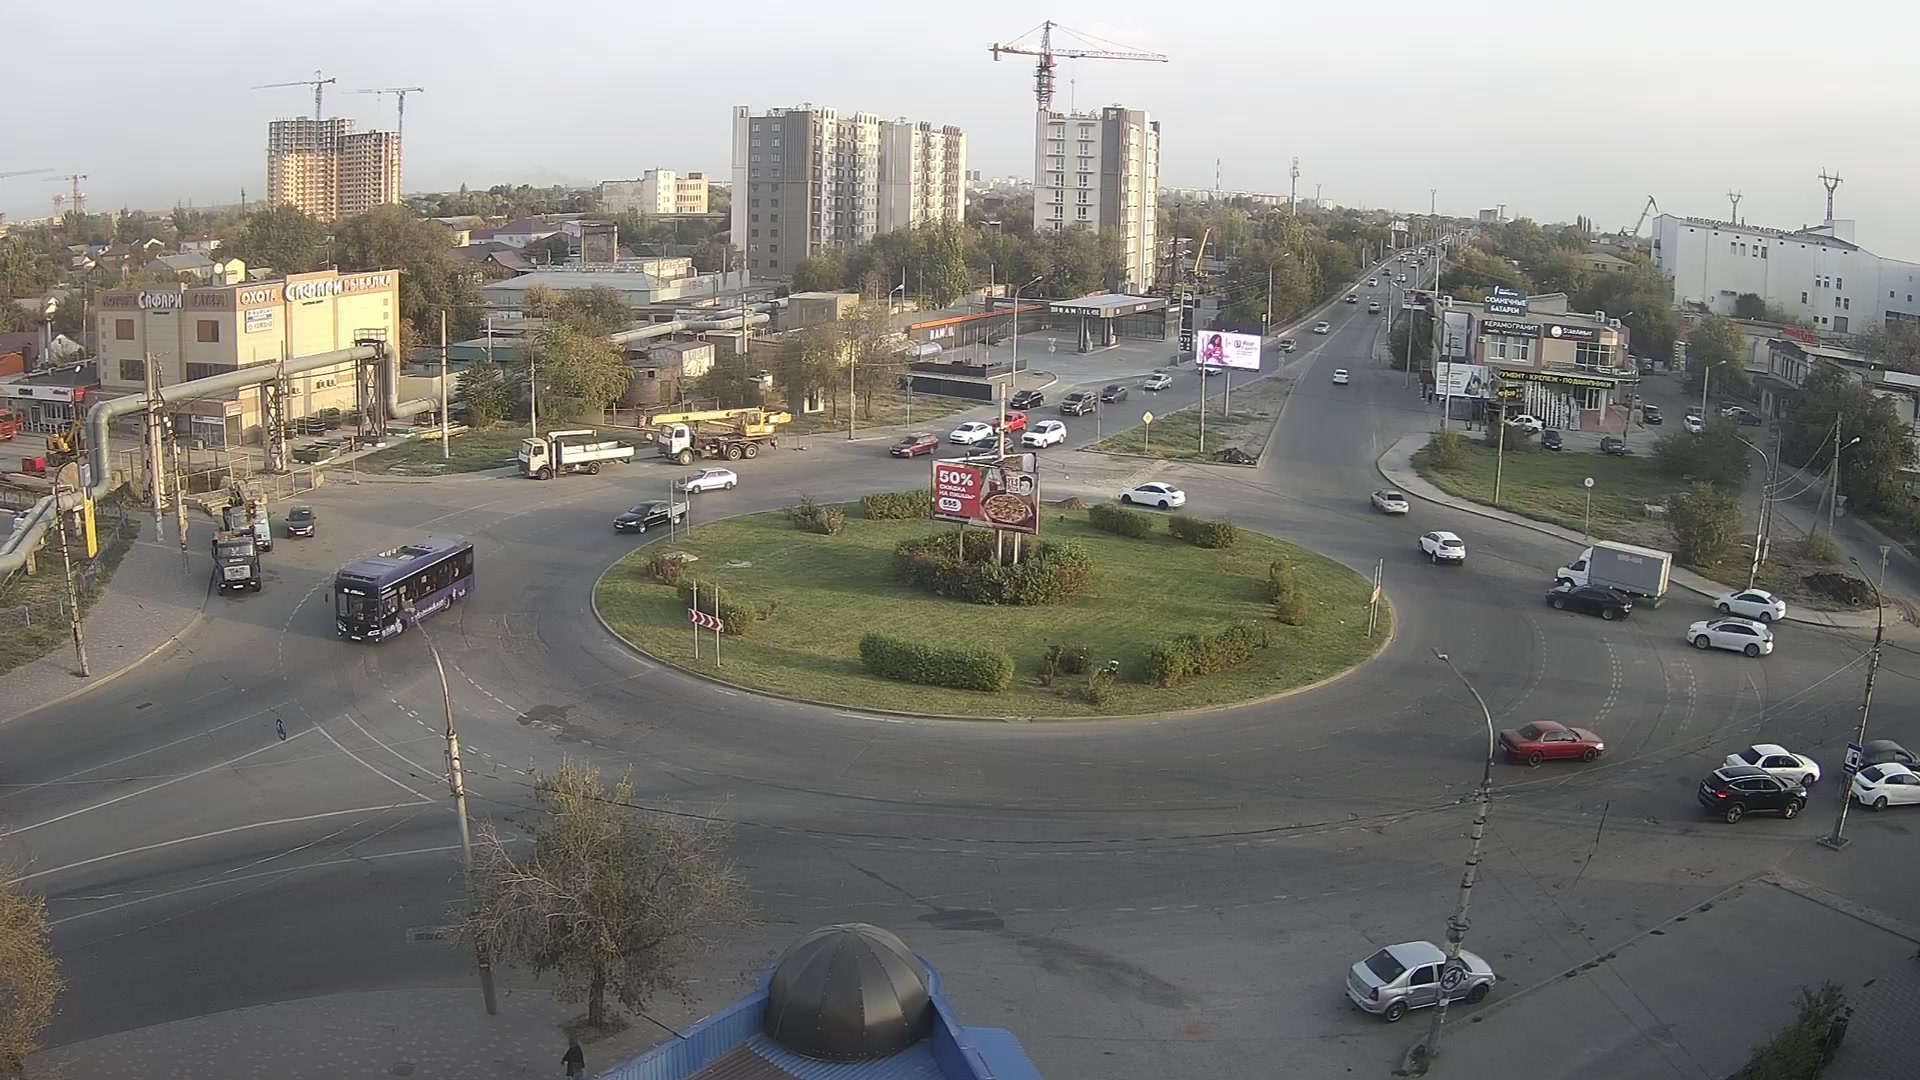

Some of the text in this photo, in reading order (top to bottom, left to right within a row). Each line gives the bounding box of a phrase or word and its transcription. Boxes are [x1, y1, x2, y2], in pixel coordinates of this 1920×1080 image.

[241, 274, 393, 305] ОХОТА САФАРИ РЫБАЛКА
[139, 291, 183, 309] САФАРИ
[1484, 320, 1539, 332] КЕРАМОГРАНИТ
[939, 470, 974, 487] 50%
